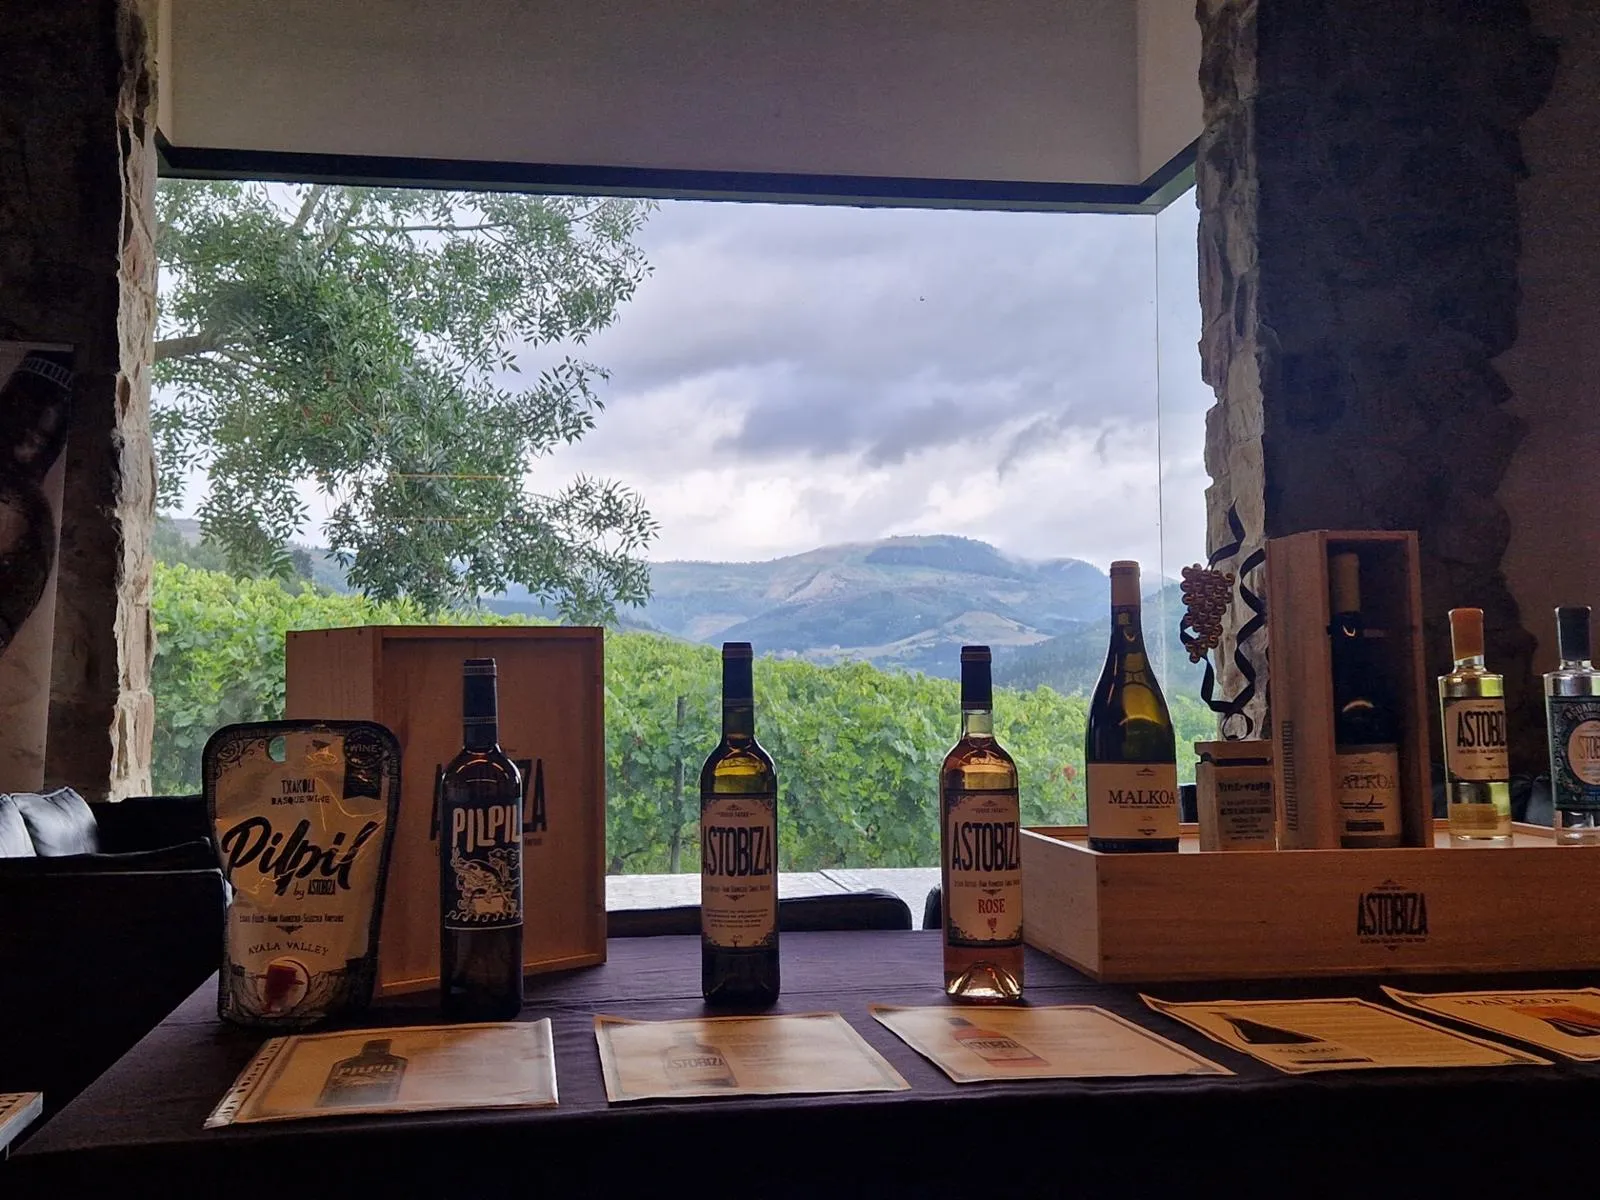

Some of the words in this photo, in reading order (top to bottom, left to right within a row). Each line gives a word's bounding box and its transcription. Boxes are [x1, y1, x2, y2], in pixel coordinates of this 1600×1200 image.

[350, 743, 378, 753] WINE
[281, 778, 315, 794] TXAKOLI
[271, 795, 305, 805] BASQUE
[306, 794, 331, 804] WINE
[1108, 789, 1175, 805] MALKOA
[452, 804, 521, 853] PILPIL
[702, 825, 772, 877] ASTOBIZA
[952, 821, 1021, 872] ASTOBIZA
[293, 883, 305, 899] by
[1357, 892, 1428, 936] ASTOBIZA
[248, 942, 281, 955] AYALA
[287, 941, 329, 956] VALLEY
